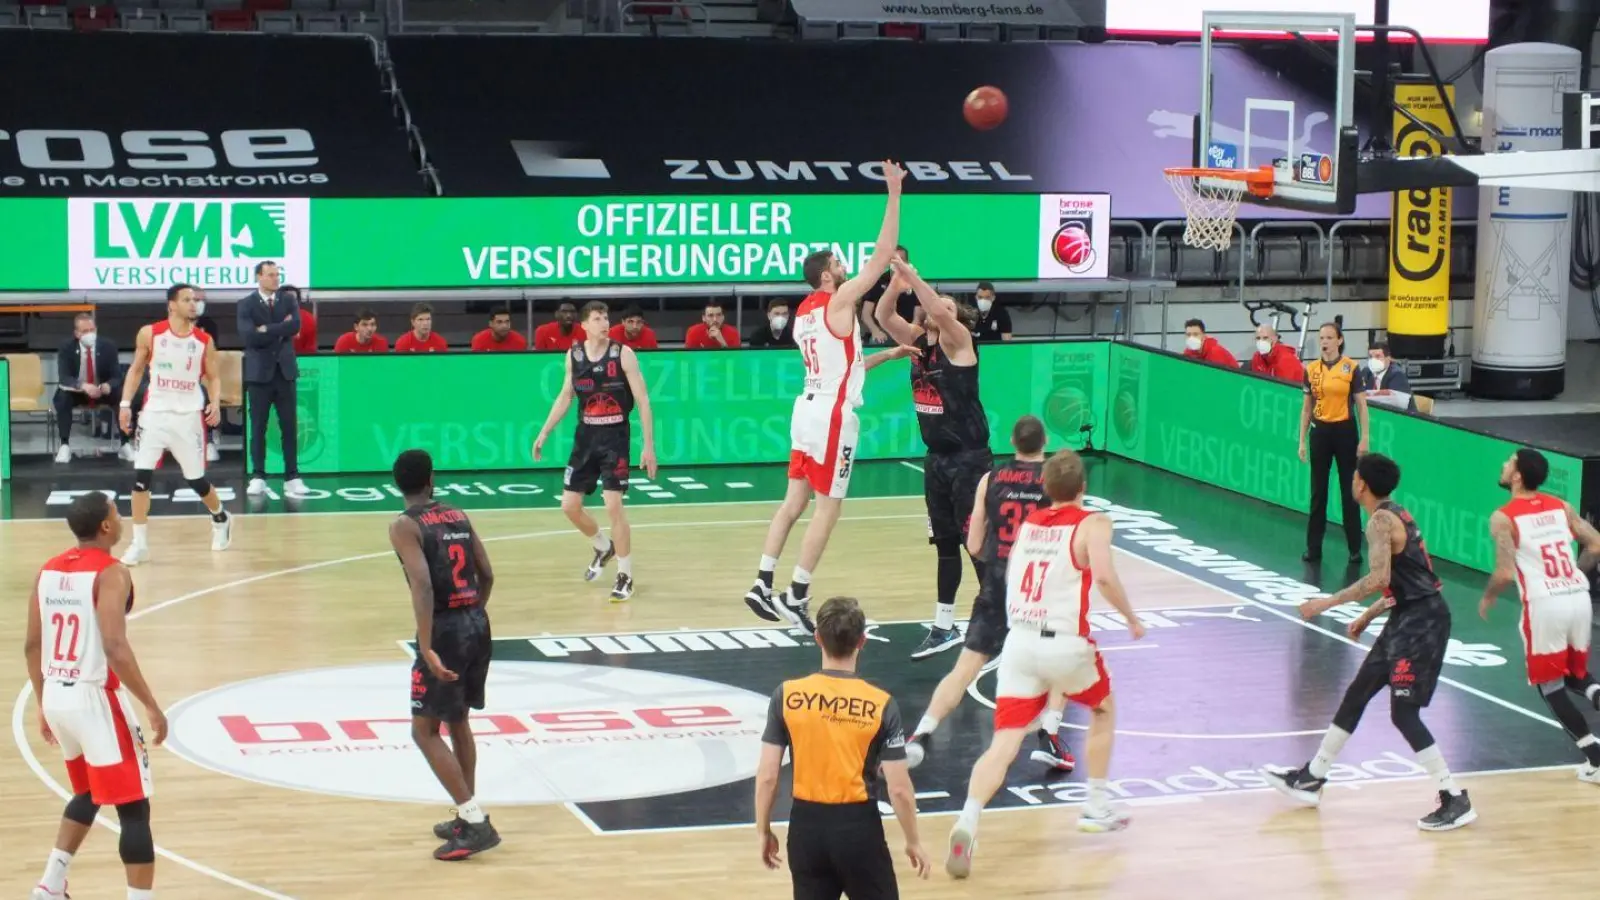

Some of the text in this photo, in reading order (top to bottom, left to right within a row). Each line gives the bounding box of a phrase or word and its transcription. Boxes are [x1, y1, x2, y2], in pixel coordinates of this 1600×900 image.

[882, 3, 1044, 17] www.bamberg-fans.de
[0, 129, 320, 169] ose
[38, 173, 70, 187] in
[83, 171, 330, 188] Mechatronics
[663, 158, 1033, 182] ZUMTOBEL
[1060, 199, 1093, 208] brose
[93, 202, 222, 259] LVM
[576, 201, 793, 237] OFFIZIELLER
[94, 266, 286, 286] VERSICHERUG
[157, 374, 196, 391] brose
[994, 470, 1033, 484] JAMES
[448, 544, 468, 588] 2
[1540, 541, 1573, 579] 55
[52, 612, 80, 662] 22
[527, 629, 800, 657] PUMA
[786, 691, 876, 719] GYMPER
[216, 705, 746, 744] brose
[240, 743, 418, 756] Excellenc
[507, 728, 760, 748] Mechatronics
